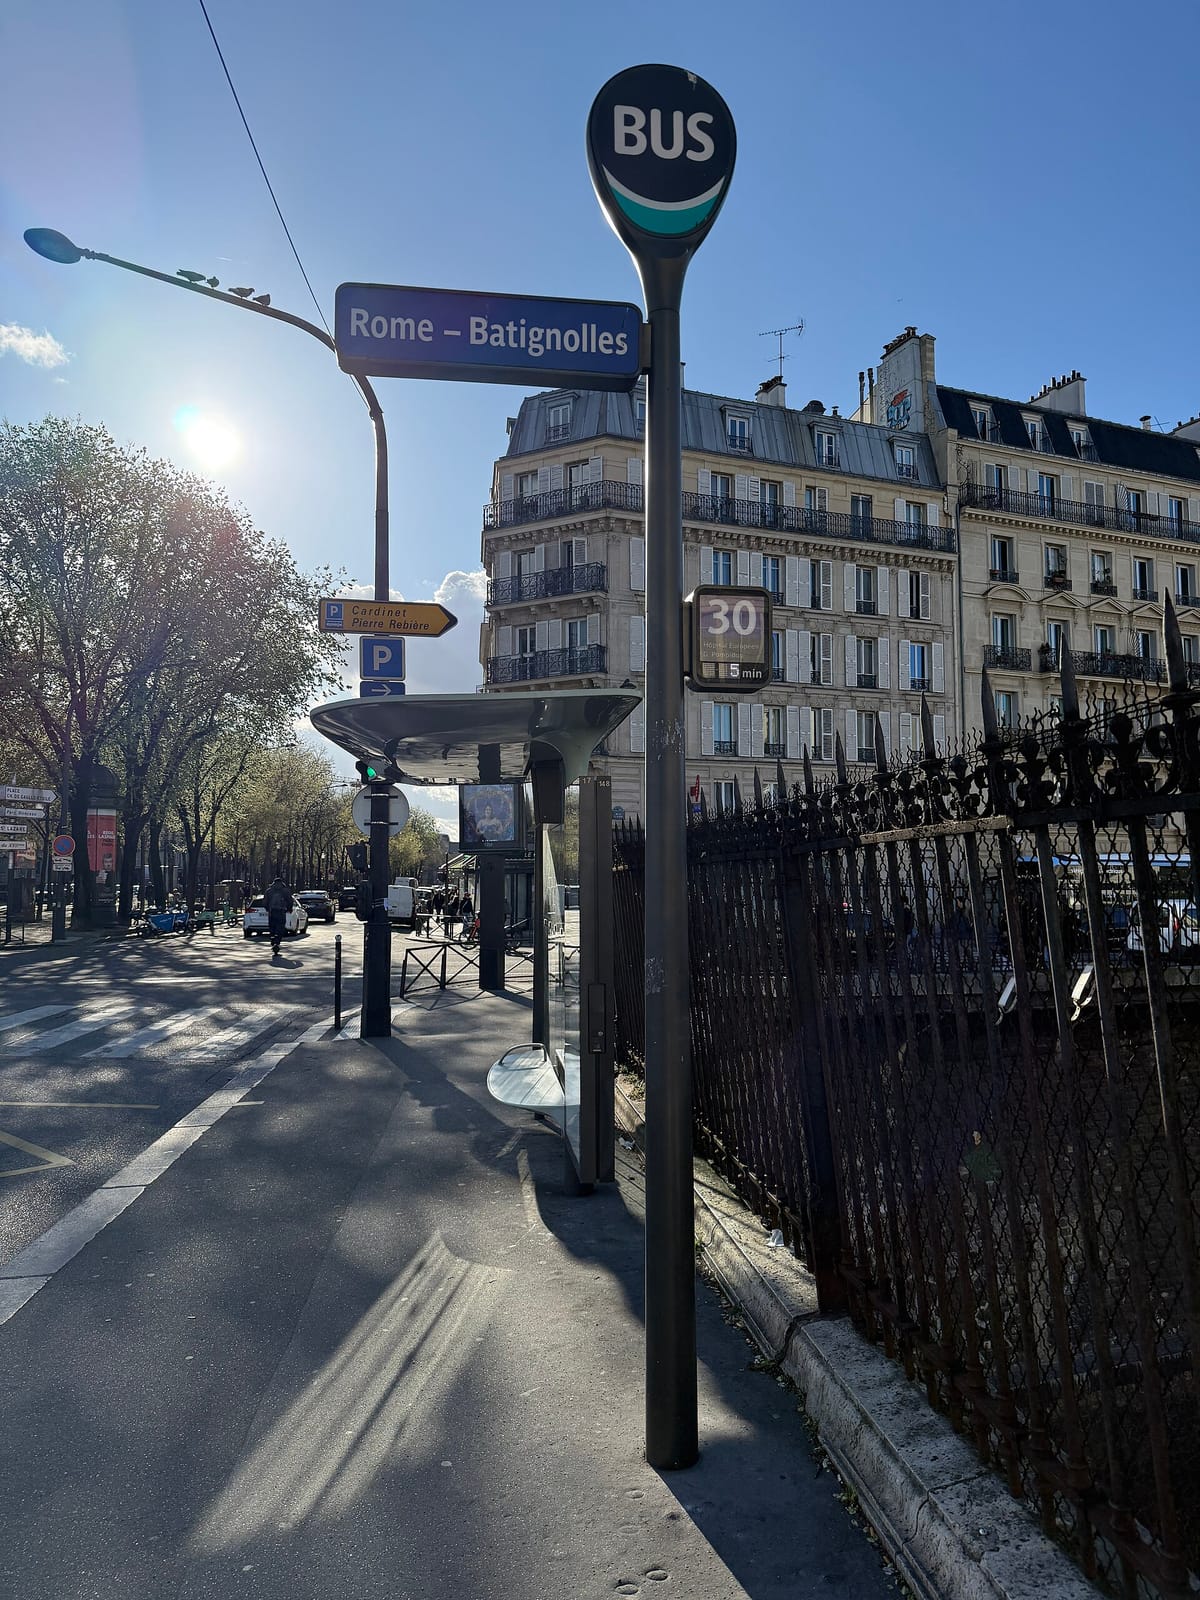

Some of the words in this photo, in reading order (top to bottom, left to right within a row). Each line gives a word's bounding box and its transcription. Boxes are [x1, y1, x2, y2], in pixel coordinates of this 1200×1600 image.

[613, 104, 715, 162] BUS
[350, 307, 434, 342] Rome
[469, 316, 628, 357] Batignolles
[351, 605, 407, 617] Cardinet
[708, 599, 757, 636] 30
[351, 618, 384, 629] Pierre
[389, 619, 430, 631] Rebière
[373, 645, 393, 671] P
[730, 663, 740, 678] 5
[742, 668, 762, 679] min
